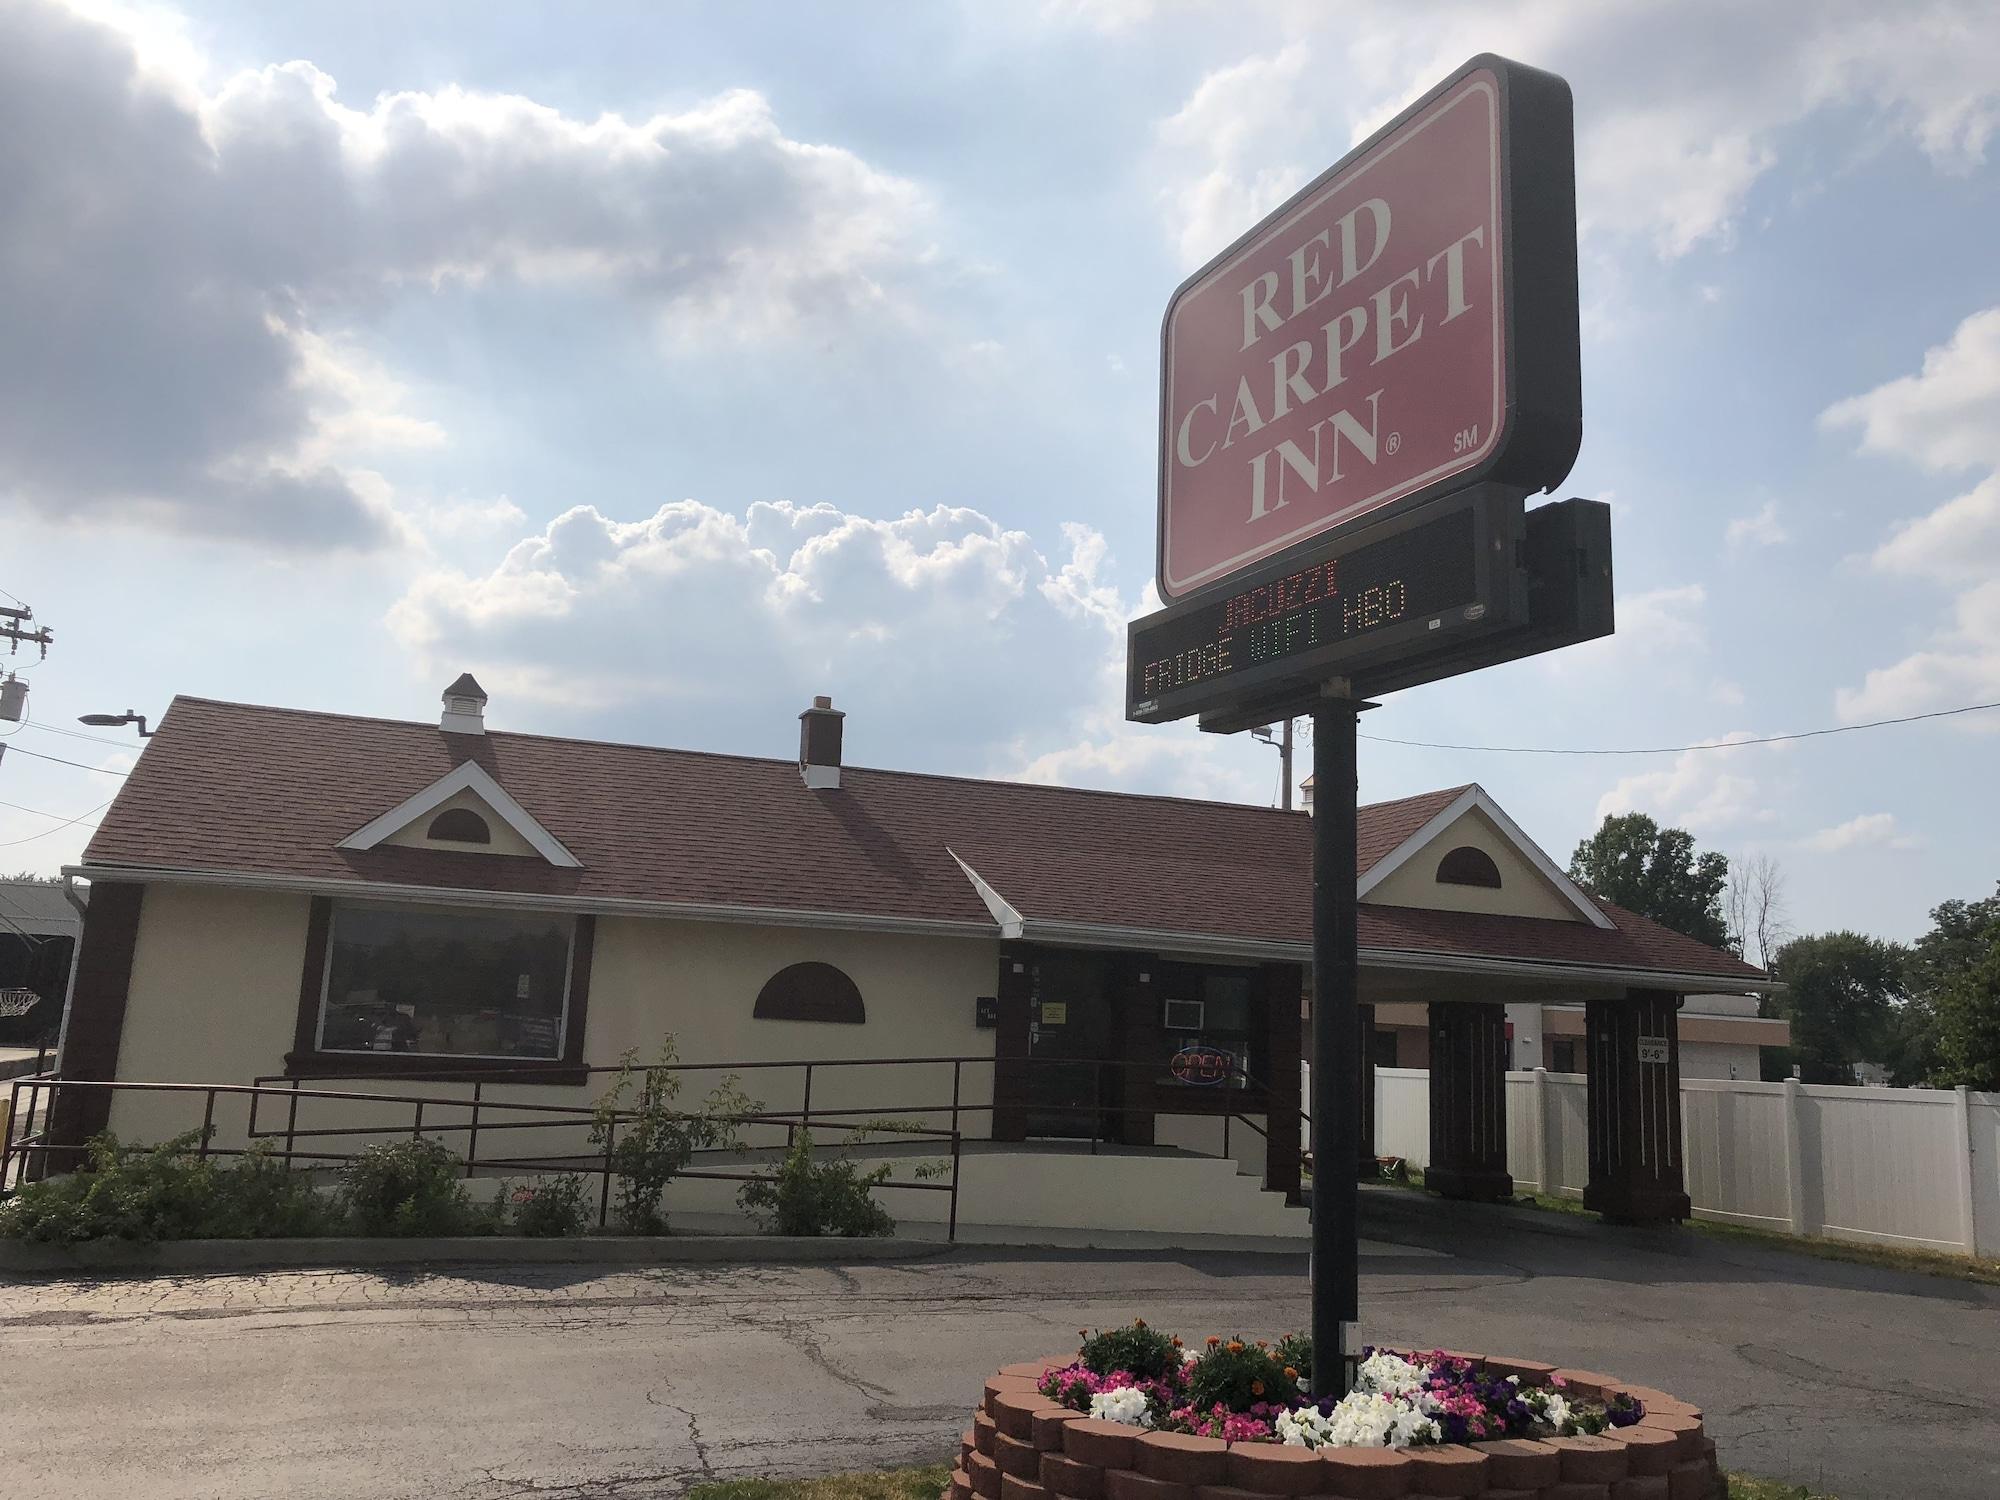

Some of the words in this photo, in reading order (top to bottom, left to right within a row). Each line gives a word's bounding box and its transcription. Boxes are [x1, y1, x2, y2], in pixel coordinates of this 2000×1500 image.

[1238, 197, 1391, 352] RED
[1177, 225, 1484, 468] CARPET
[1246, 389, 1384, 524] INN
[1453, 424, 1478, 453] SM
[1144, 637, 1232, 694] FRIDGE
[1251, 609, 1318, 660] WIFI
[1343, 580, 1405, 633] HBO
[1217, 560, 1338, 634] JACUZZI
[1171, 1053, 1232, 1078] OPEN
